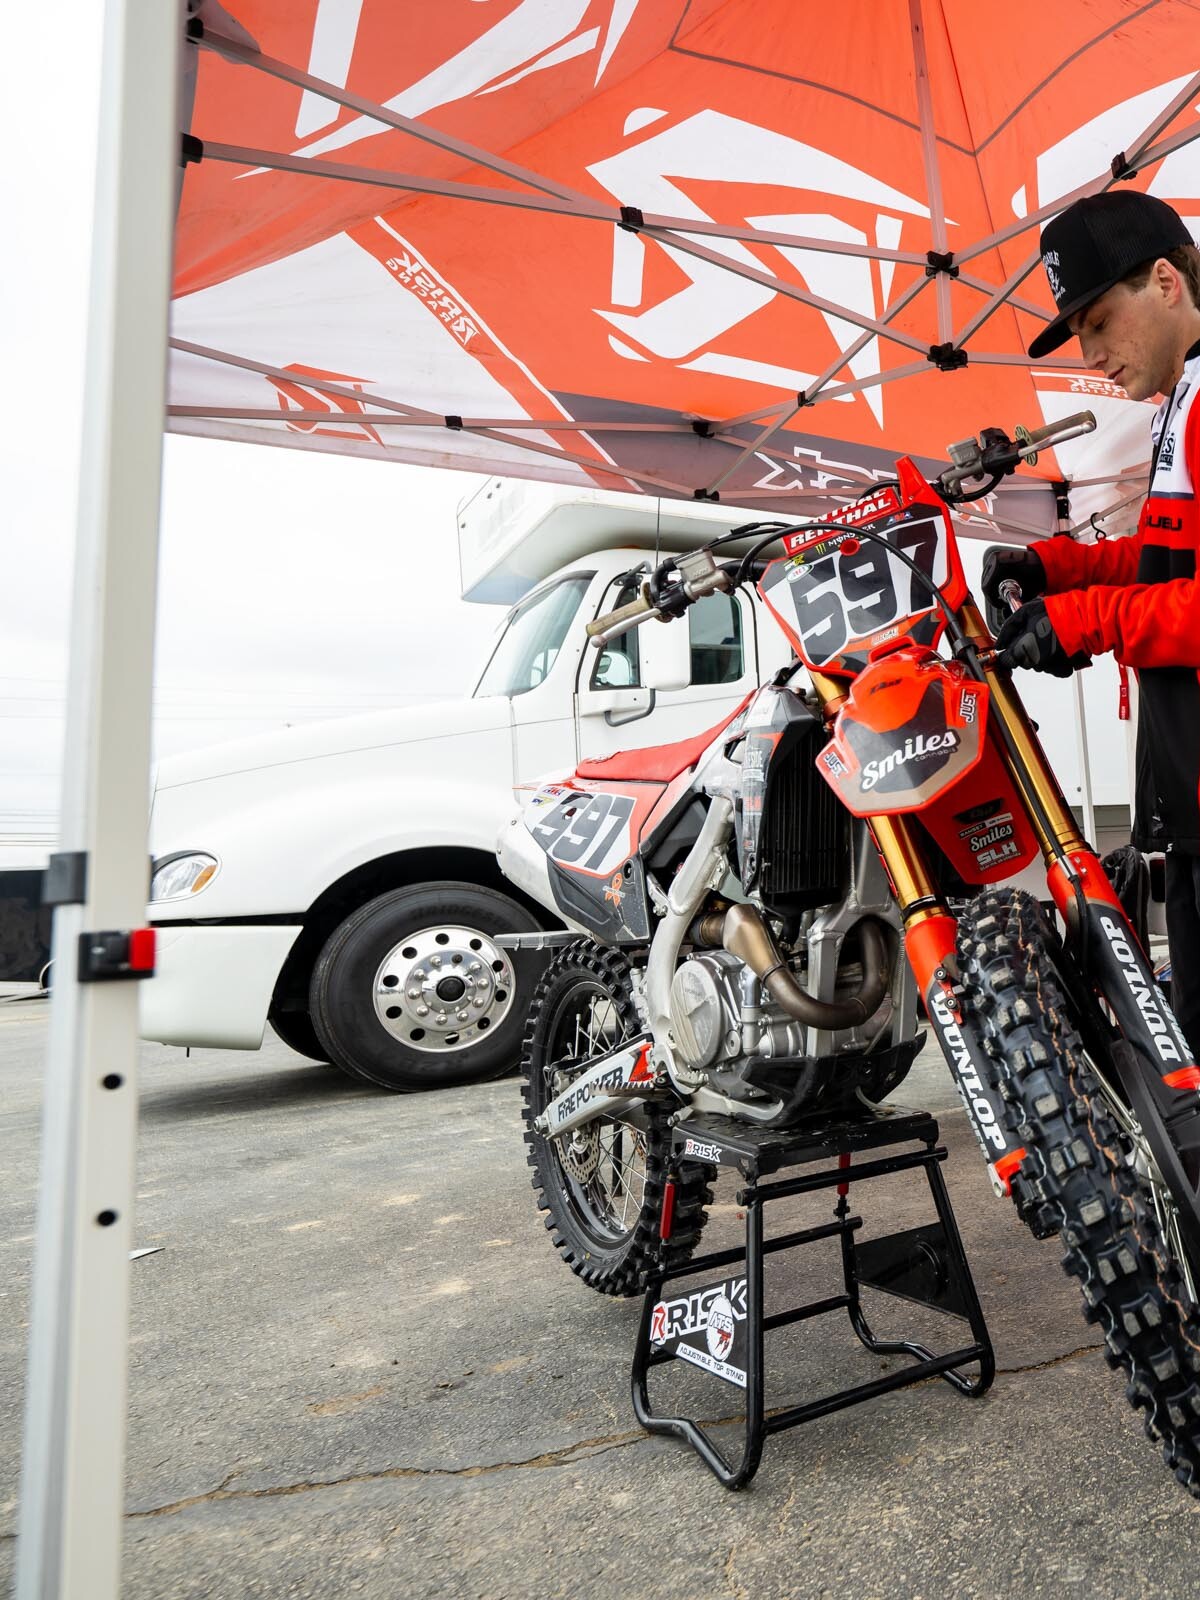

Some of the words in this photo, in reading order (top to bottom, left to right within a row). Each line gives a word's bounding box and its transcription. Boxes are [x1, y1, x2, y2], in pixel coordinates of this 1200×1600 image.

[788, 519, 939, 667] 597
[861, 730, 957, 790] Smiles
[914, 747, 958, 762] cannabis
[530, 791, 636, 871] 597
[970, 823, 1014, 852] Smiles
[976, 840, 1018, 867] SLH
[1100, 916, 1182, 1063] DUNLOP
[932, 1000, 1008, 1151] DUNLOP
[690, 1142, 722, 1163] RISK
[679, 1345, 712, 1368] ADJUSTABLE
[713, 1361, 725, 1372] TOP
[725, 1367, 745, 1382] STAND
